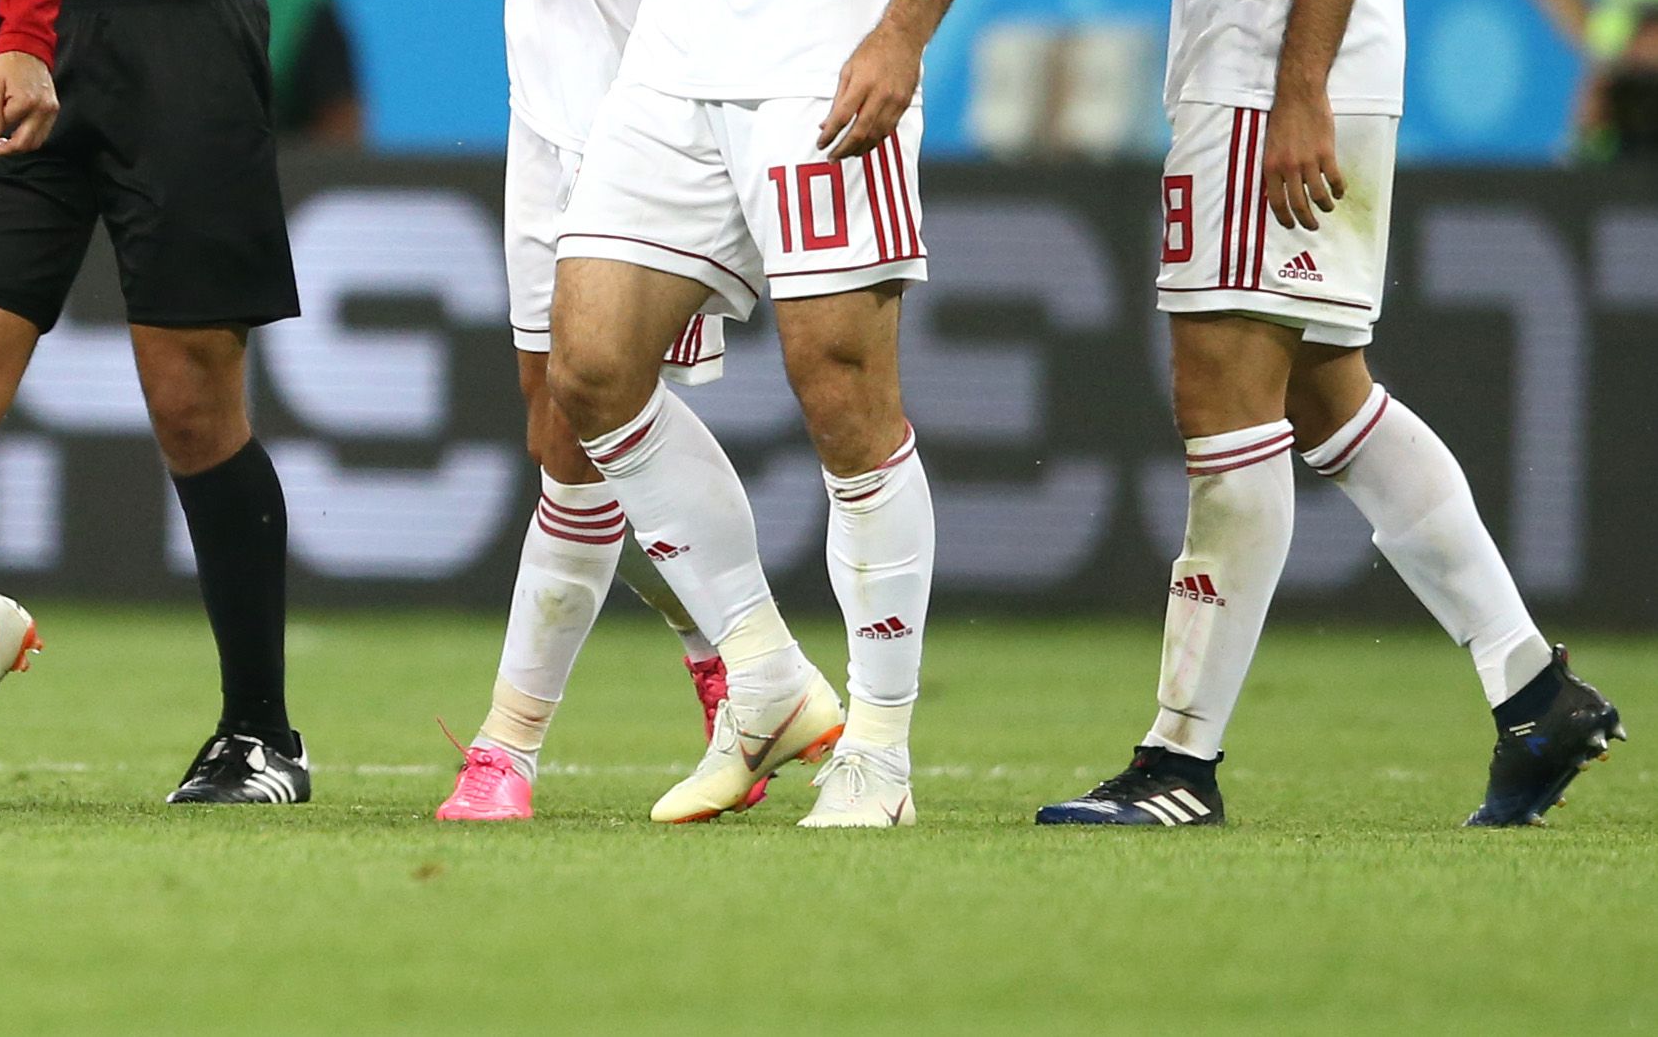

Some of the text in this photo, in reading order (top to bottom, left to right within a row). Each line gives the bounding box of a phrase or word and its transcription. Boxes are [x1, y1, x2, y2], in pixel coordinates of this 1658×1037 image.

[768, 162, 849, 253] 10
[1278, 268, 1323, 282] adidas
[1168, 586, 1226, 606] adidas
[855, 627, 913, 640] adidas
